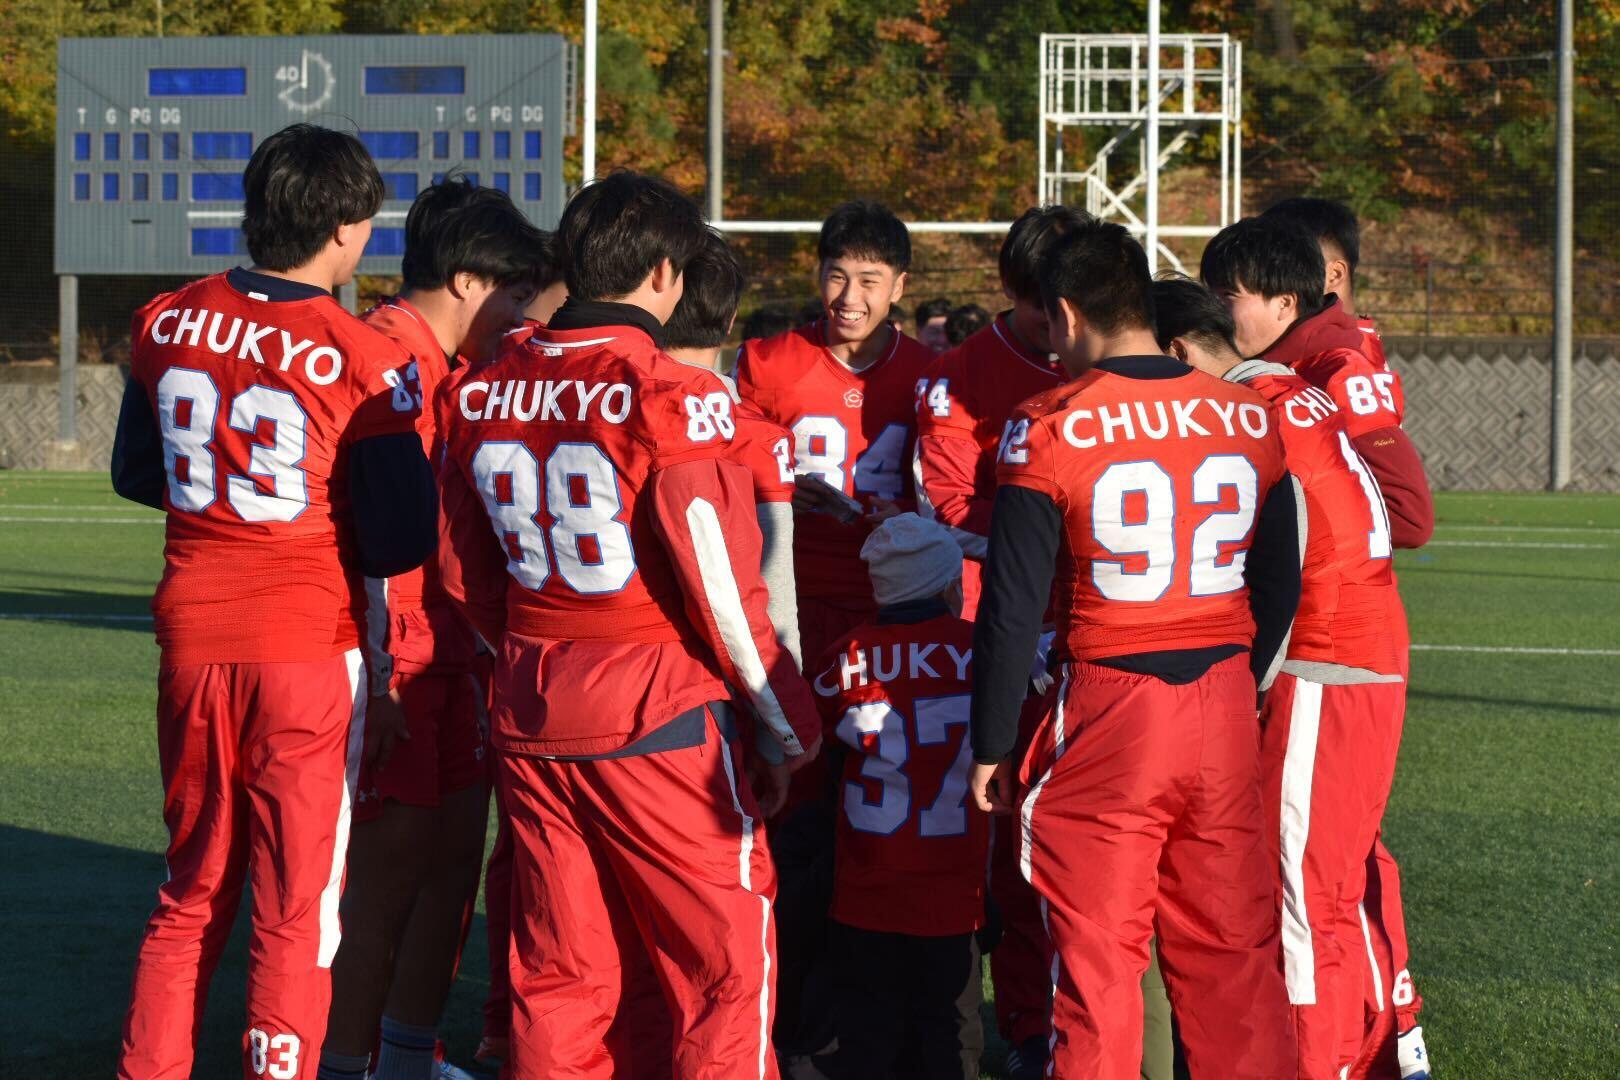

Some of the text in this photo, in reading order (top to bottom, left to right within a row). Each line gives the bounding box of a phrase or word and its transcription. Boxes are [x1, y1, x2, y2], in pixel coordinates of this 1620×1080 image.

[275, 65, 299, 82] 40
[77, 107, 181, 124] T G PG DG
[435, 105, 543, 123] T G PG DG
[151, 309, 342, 385] CHUKYO
[459, 379, 631, 423] CHUKYO
[685, 391, 735, 442] 88
[1345, 374, 1396, 416] 85
[158, 366, 309, 522] 83
[1063, 399, 1269, 448] CHUKYO
[472, 441, 637, 594] 88
[1091, 454, 1258, 602] 92
[836, 694, 973, 837] 37
[248, 1027, 301, 1080] 83
